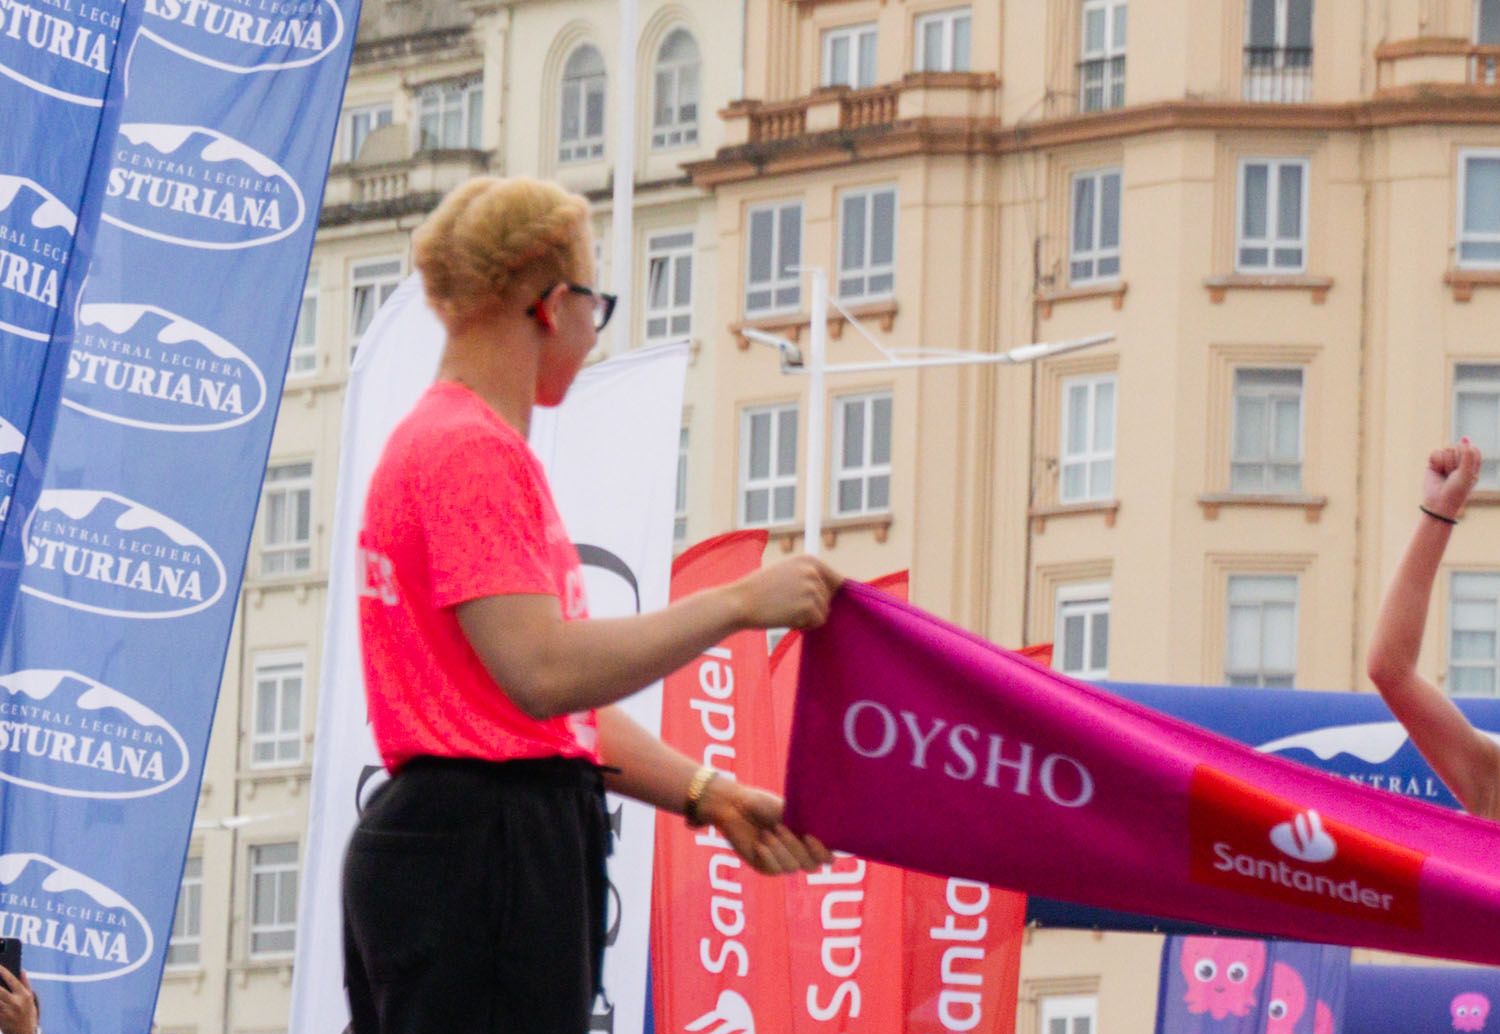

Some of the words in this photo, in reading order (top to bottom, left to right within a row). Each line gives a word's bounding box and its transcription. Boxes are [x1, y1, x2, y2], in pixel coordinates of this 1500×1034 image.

[105, 168, 282, 230] STURIANA
[117, 151, 195, 178] CENTRAL
[204, 172, 281, 194] LECHERA
[66, 350, 244, 415] STURIANA
[160, 351, 243, 378] LECHERA
[25, 535, 203, 602] STURIANA
[38, 521, 111, 548] ENTRAL
[119, 538, 202, 566] LECHERA
[0, 720, 166, 782] STURIANA
[81, 718, 165, 746] LECHERA
[843, 699, 1095, 808] OYSHO
[1213, 843, 1394, 912] Santander
[0, 911, 129, 964] URIANA
[47, 900, 128, 928] LECHERA
[806, 852, 868, 1022] Sant
